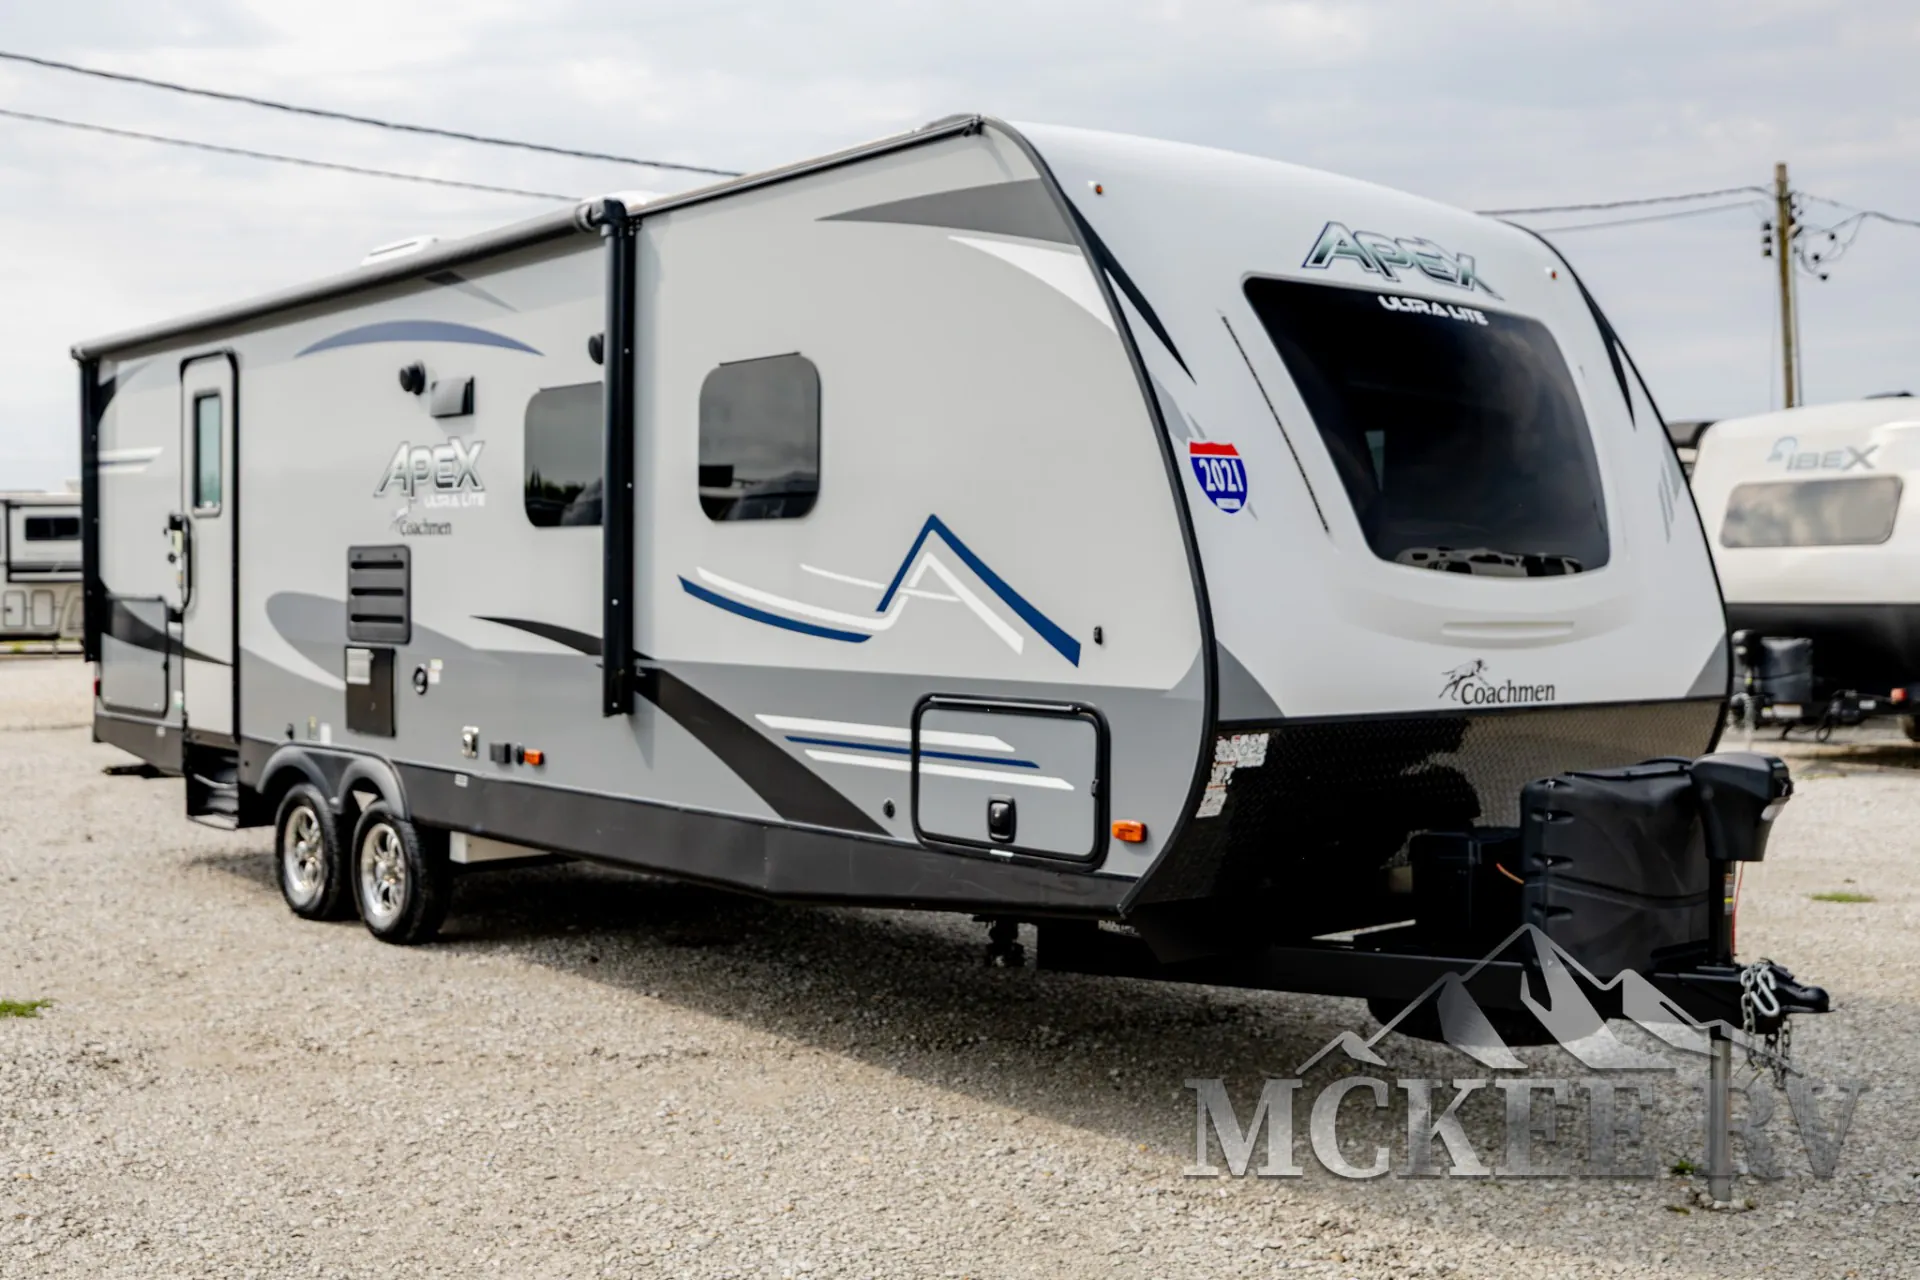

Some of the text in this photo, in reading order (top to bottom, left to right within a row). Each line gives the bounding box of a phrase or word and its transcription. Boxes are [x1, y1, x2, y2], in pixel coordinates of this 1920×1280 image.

[1302, 221, 1504, 301] APEX
[1378, 295, 1489, 325] ULTRA LITE
[373, 436, 486, 500] APEX
[1786, 445, 1879, 472] IBEX
[1198, 458, 1244, 492] 2021
[400, 518, 452, 537] Coachmen
[1461, 680, 1556, 705] Coachmen
